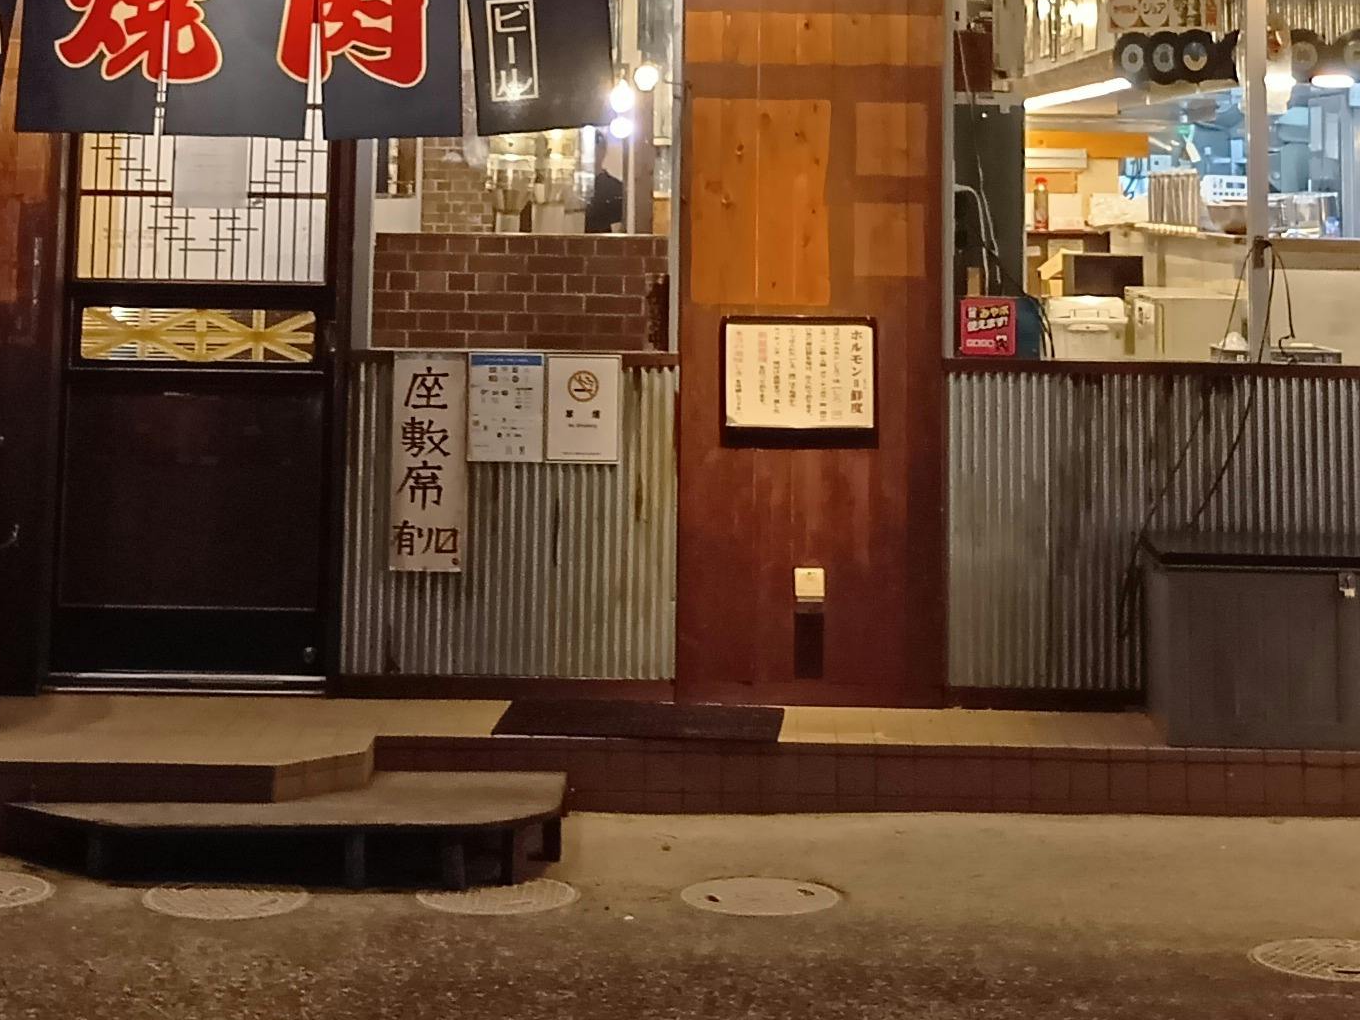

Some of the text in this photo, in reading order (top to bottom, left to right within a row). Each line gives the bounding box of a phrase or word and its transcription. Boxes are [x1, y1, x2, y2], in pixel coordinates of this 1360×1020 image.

[492, 2, 534, 97] ビール
[395, 366, 451, 511] 座敷席
